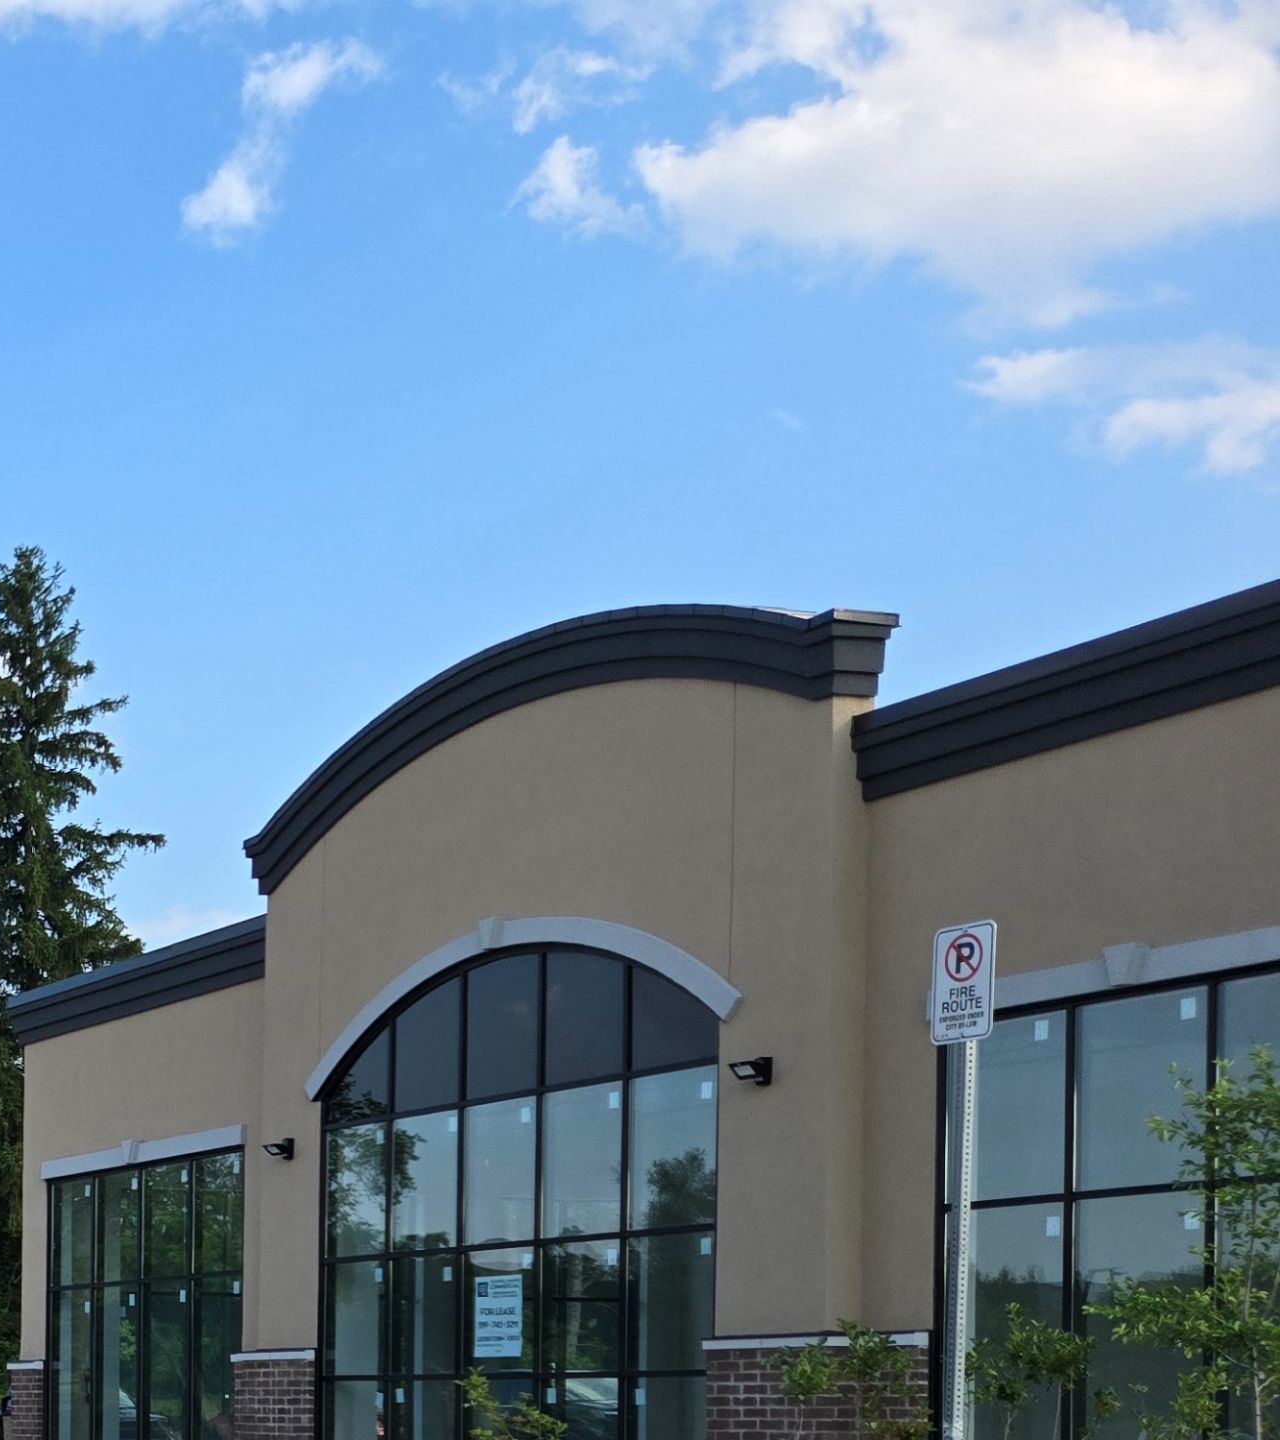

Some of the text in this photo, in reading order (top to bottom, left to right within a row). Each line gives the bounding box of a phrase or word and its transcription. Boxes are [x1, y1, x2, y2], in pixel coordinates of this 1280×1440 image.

[949, 985, 976, 1000] FIRE
[942, 996, 983, 1014] ROUTE
[939, 1011, 984, 1024] ENFORCED UNDER
[945, 1020, 977, 1031] CITY BY-LAW
[480, 1306, 516, 1316] FOR LEASE
